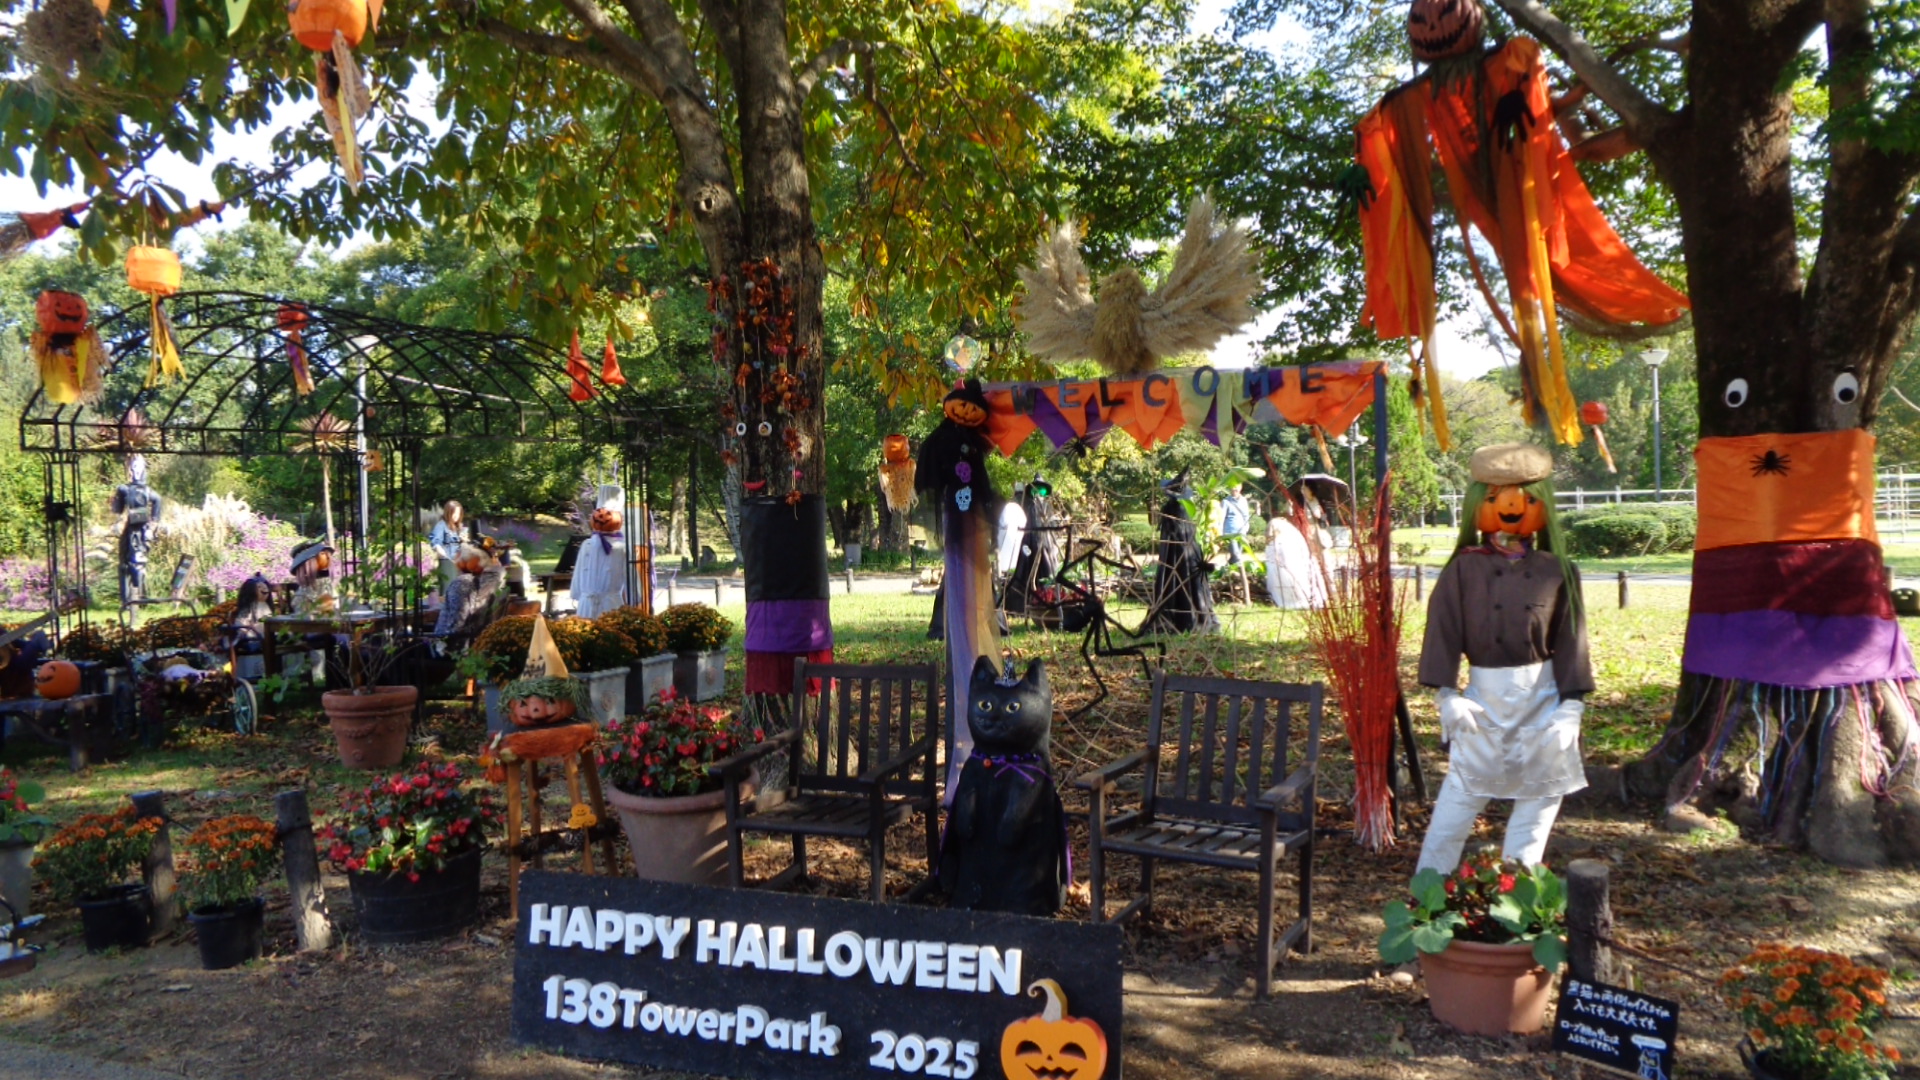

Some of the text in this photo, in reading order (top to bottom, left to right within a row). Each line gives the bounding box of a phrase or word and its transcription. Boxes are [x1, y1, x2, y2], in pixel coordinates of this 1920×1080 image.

[1011, 363, 1324, 415] WELCOME
[529, 903, 1022, 996] HAPPY HALLOWEEN
[543, 975, 979, 1079] 138TowerPark 2025
